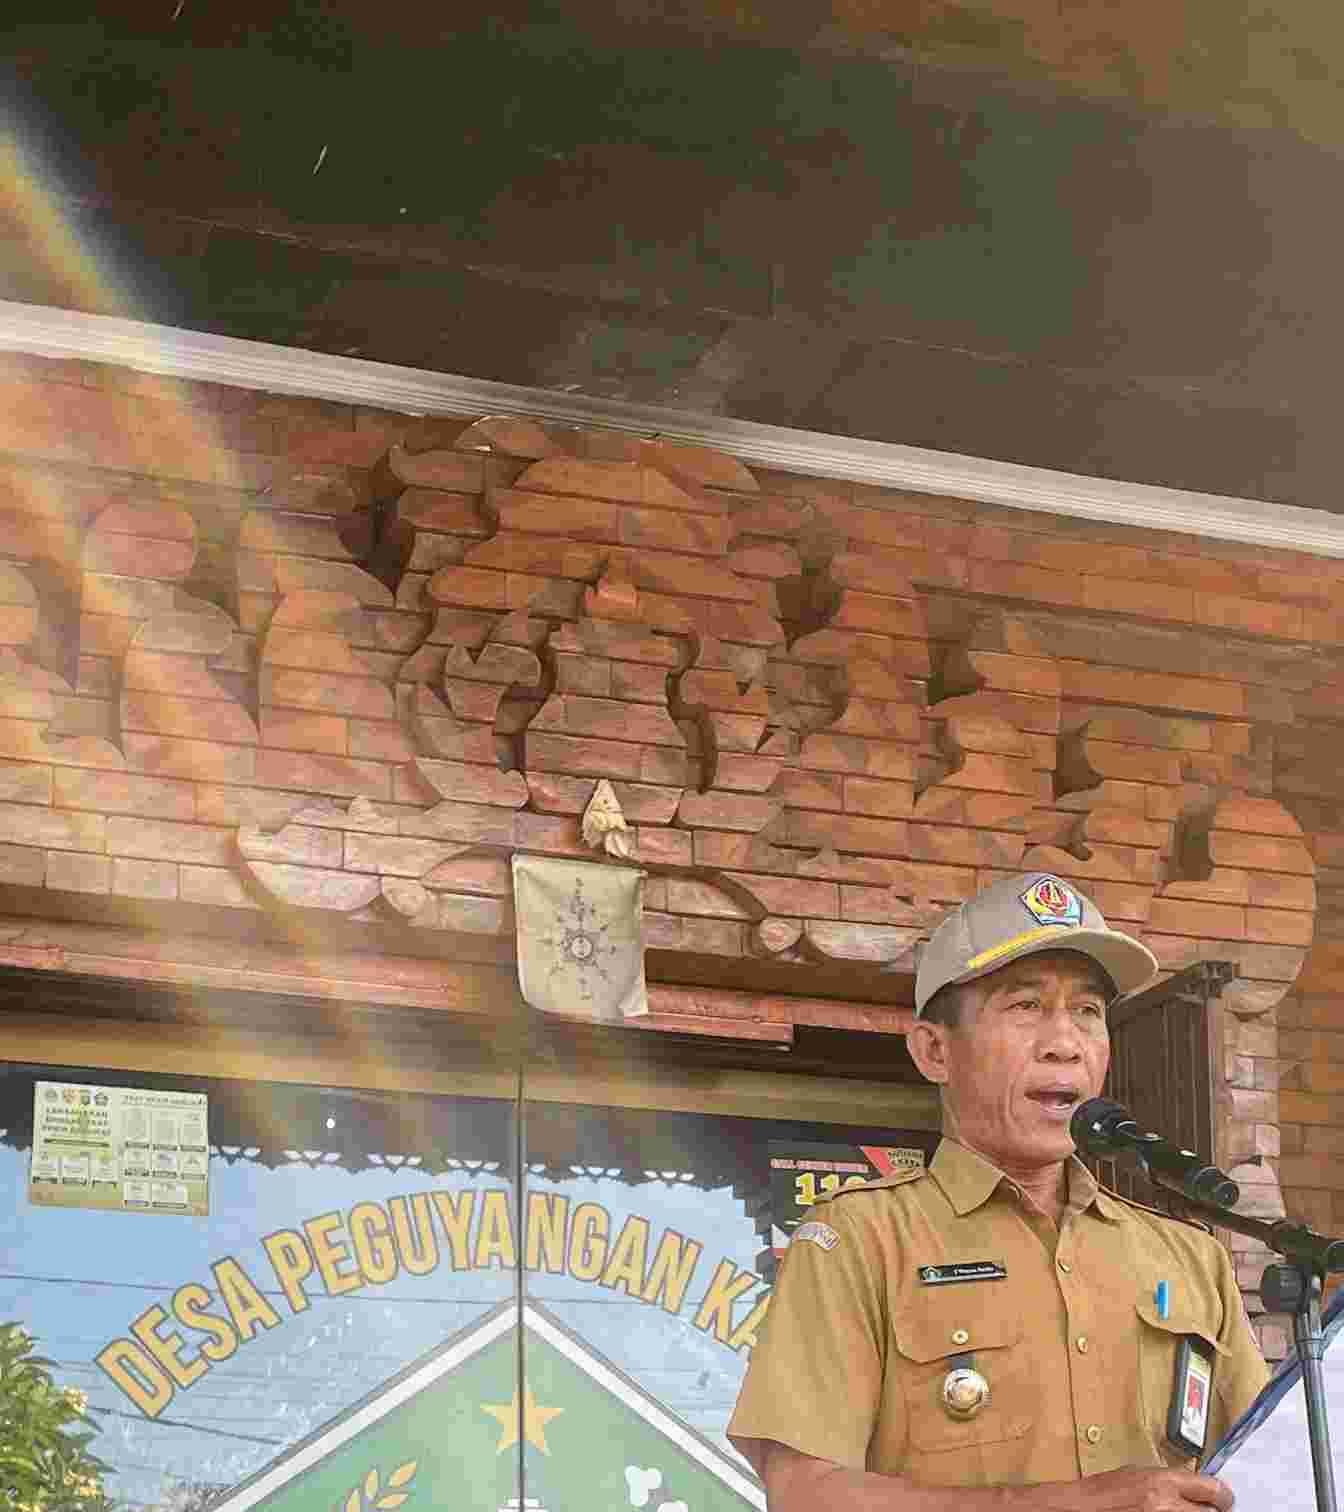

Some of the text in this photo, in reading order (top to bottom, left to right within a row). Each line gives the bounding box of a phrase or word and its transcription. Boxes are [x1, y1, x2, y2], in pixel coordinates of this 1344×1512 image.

[94, 1190, 774, 1420] DESA PEGUYANGAN KA
